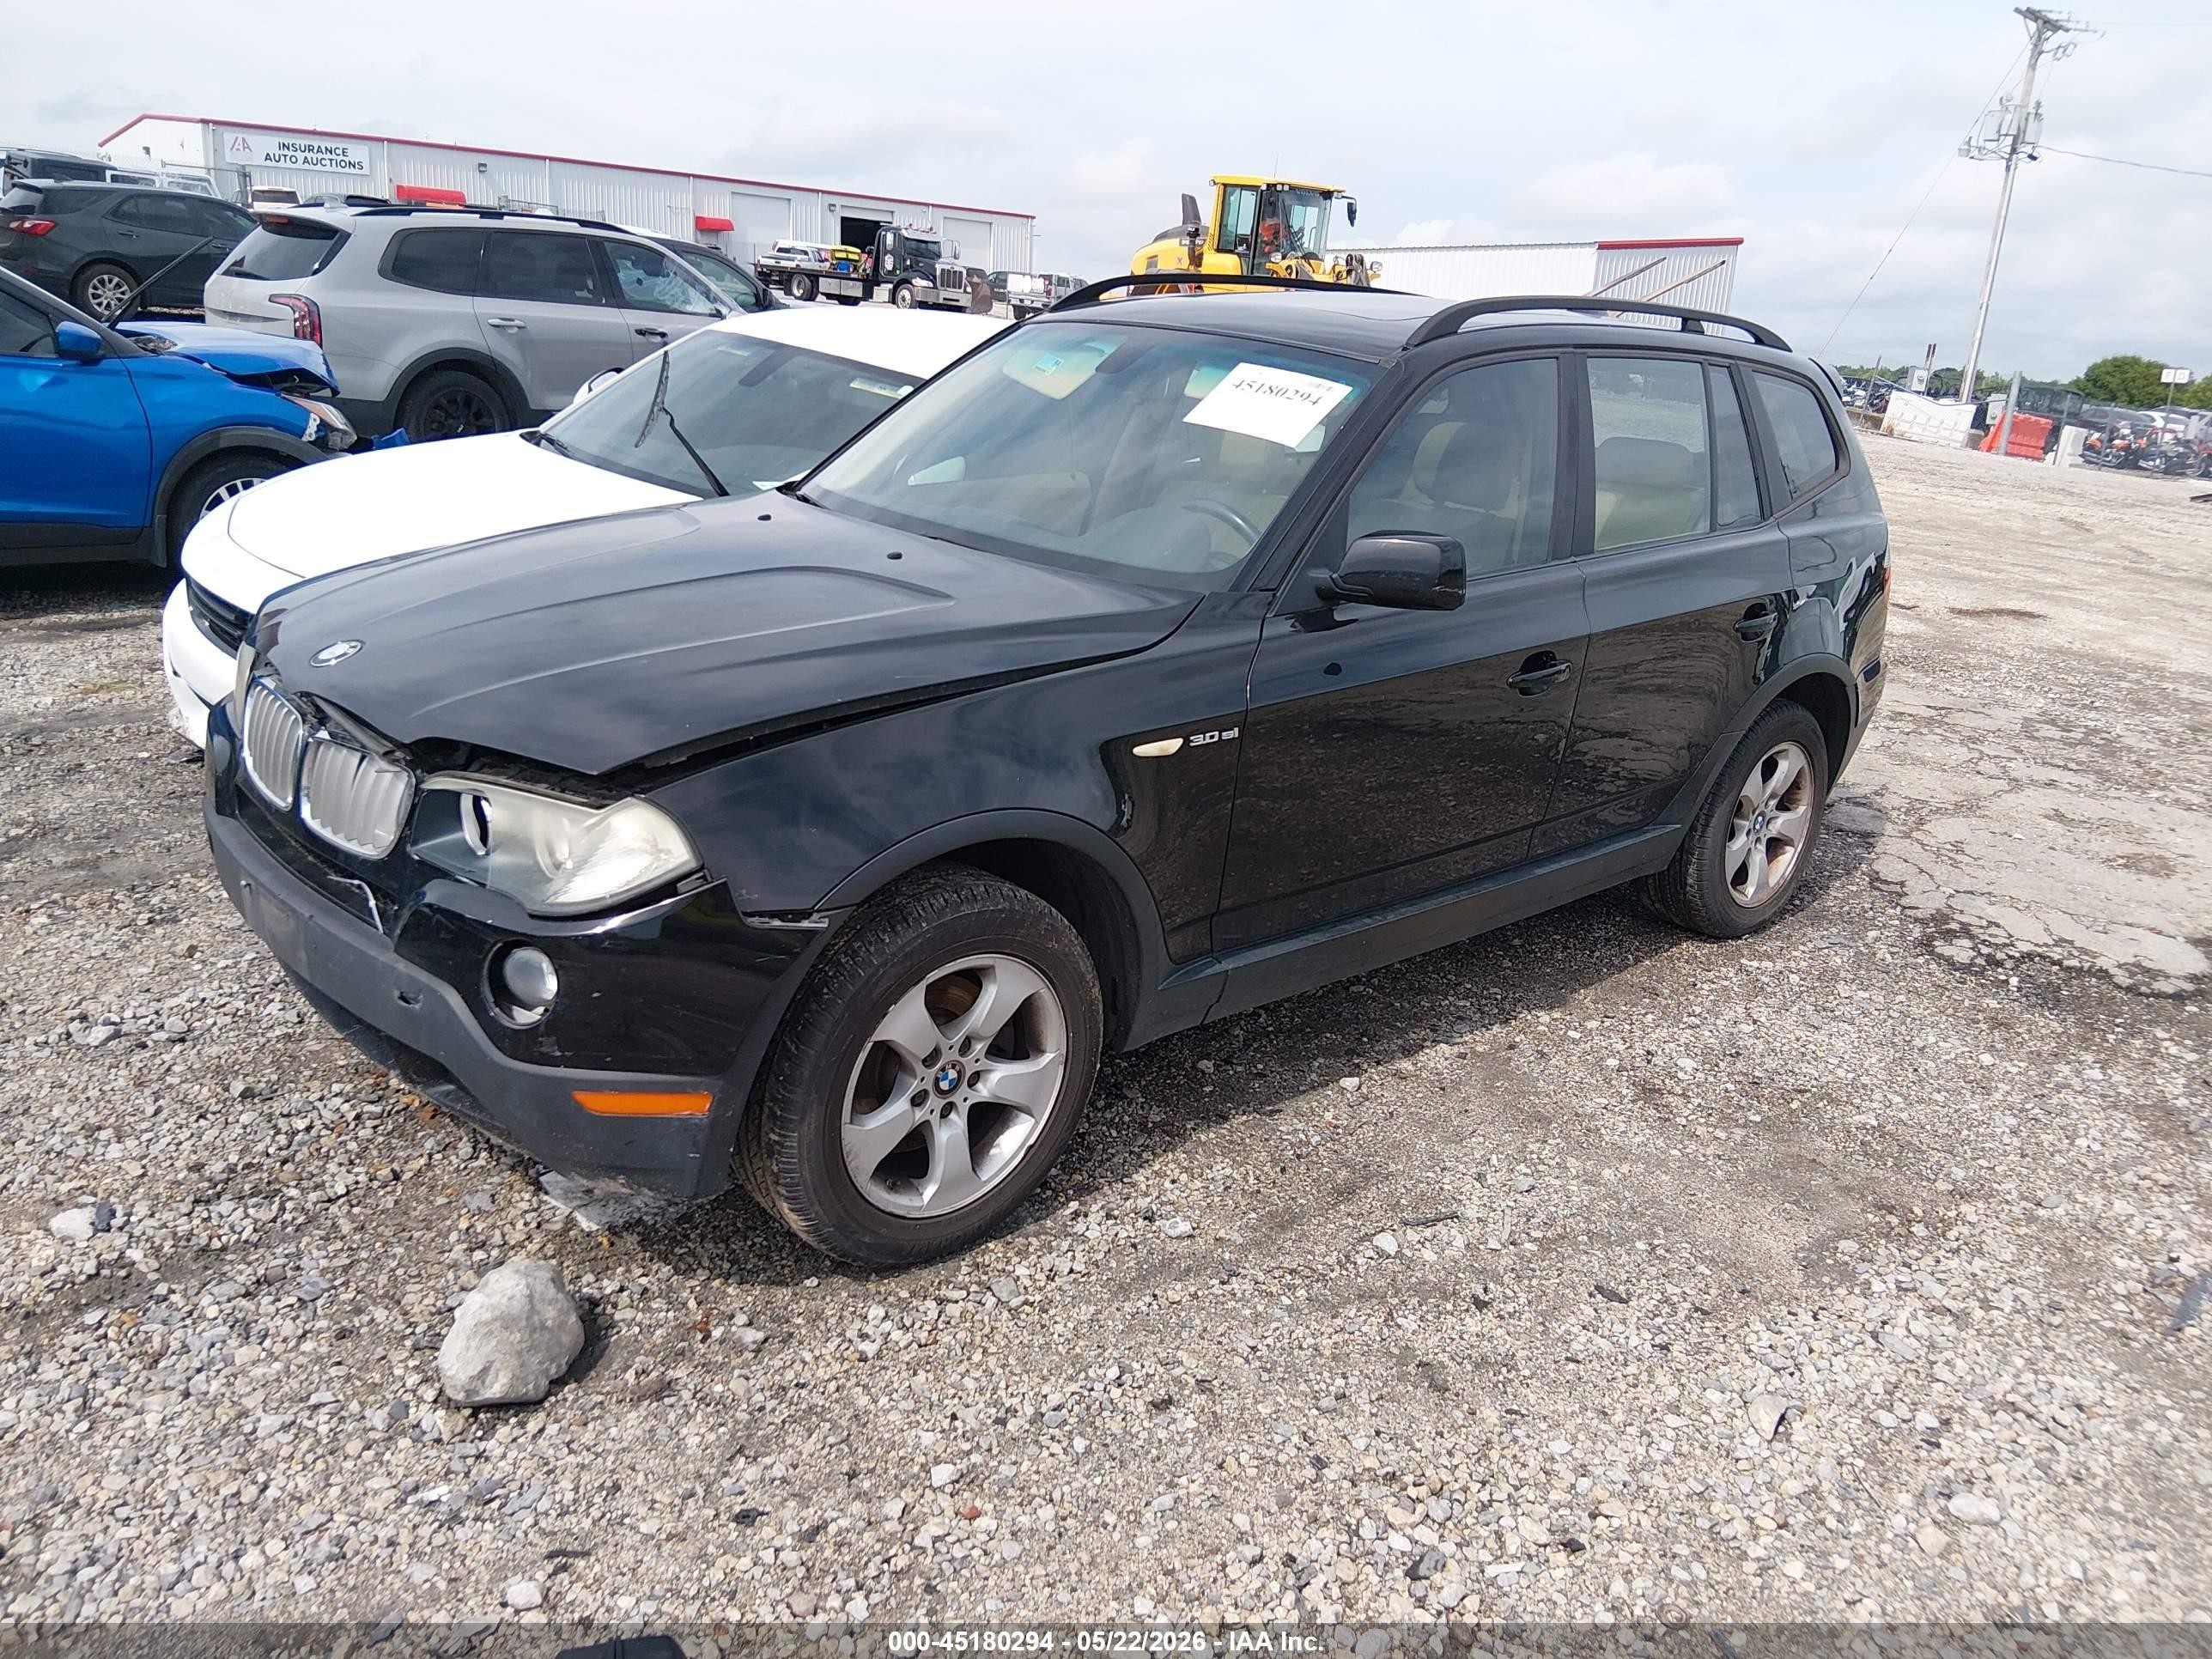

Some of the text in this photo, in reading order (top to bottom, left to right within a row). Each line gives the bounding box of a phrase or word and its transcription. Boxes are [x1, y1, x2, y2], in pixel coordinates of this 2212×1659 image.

[278, 141, 349, 157] INSURANCE
[264, 153, 364, 171] AUTO AUCTIONS
[1233, 379, 1323, 406] 45180294
